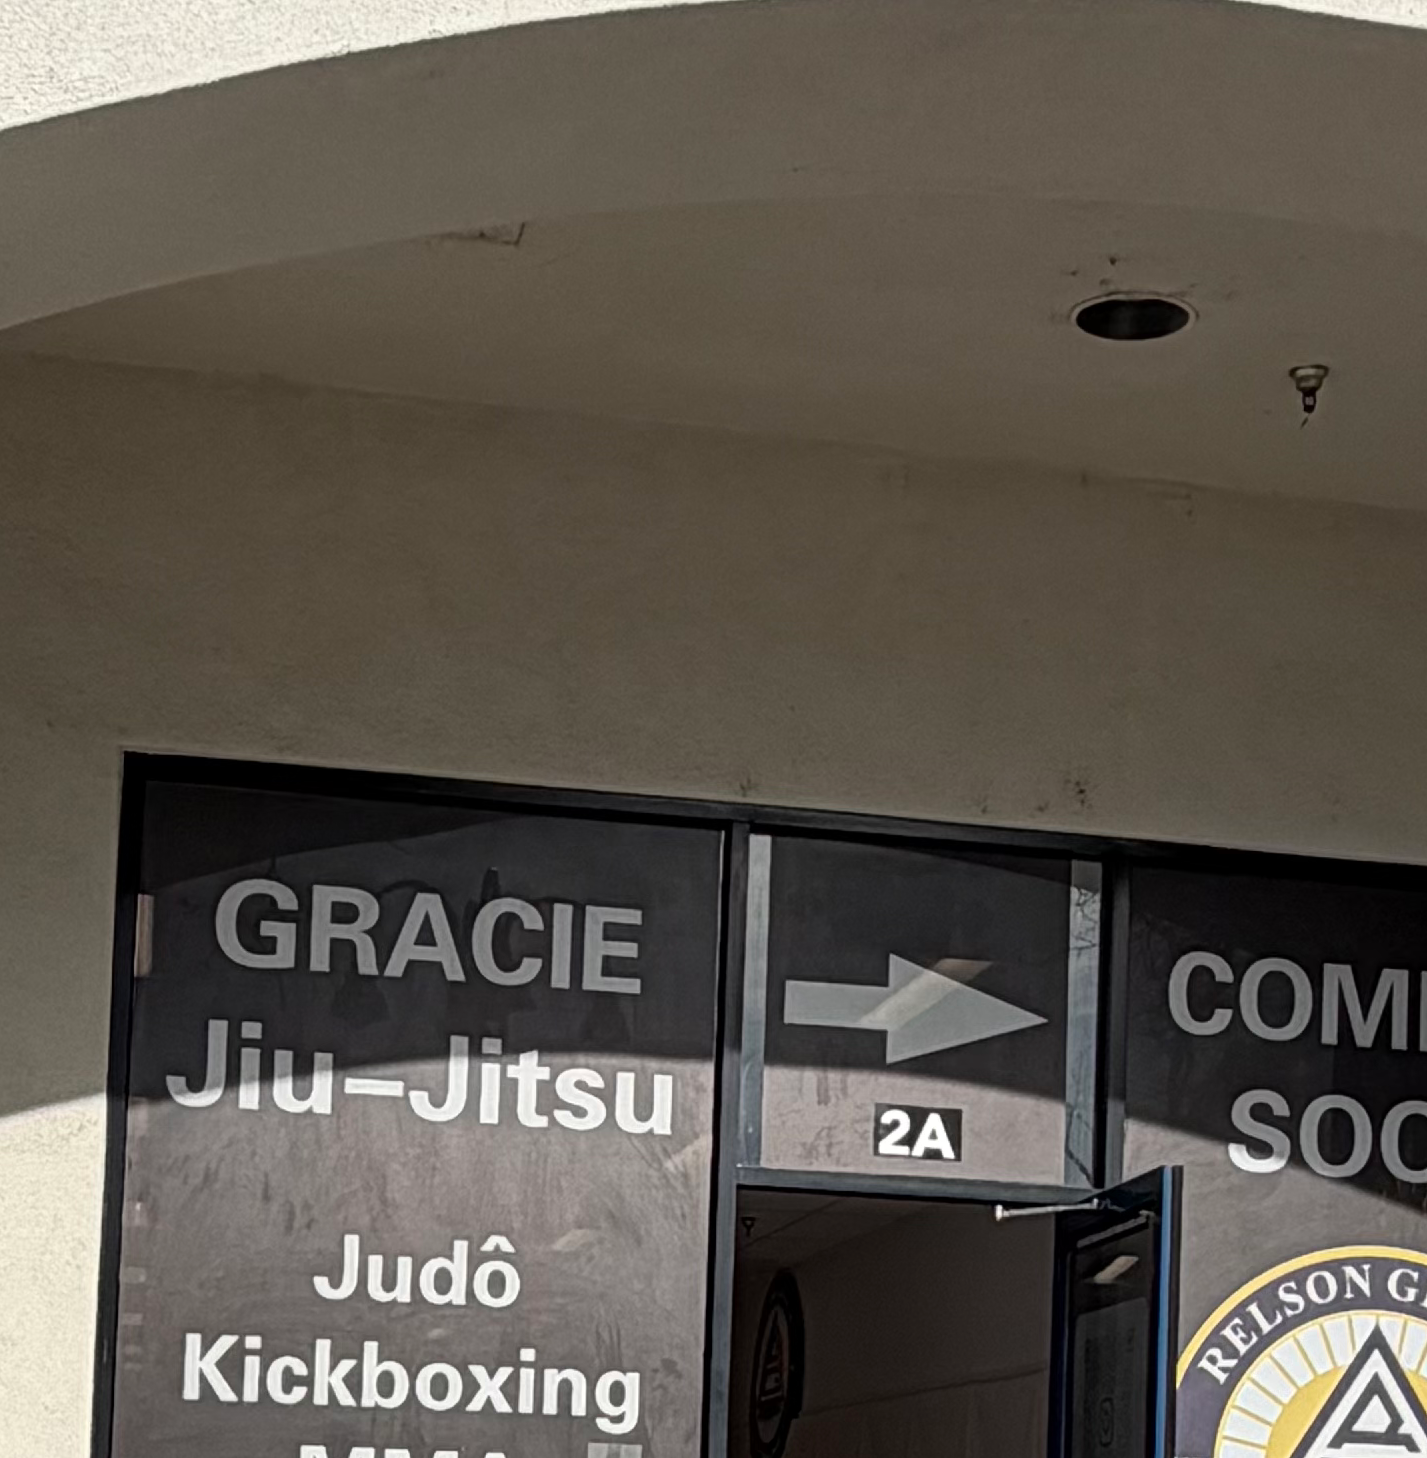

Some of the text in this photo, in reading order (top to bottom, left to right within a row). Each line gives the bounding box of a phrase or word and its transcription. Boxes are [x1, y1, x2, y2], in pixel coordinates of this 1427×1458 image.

[214, 878, 643, 995] GRACIE
[166, 1019, 673, 1135] Jiu-Jitsu
[878, 1109, 955, 1159] 2A
[313, 1234, 521, 1308] Judô
[1197, 1264, 1372, 1386] RELSON
[182, 1332, 640, 1435] Kickboxing
